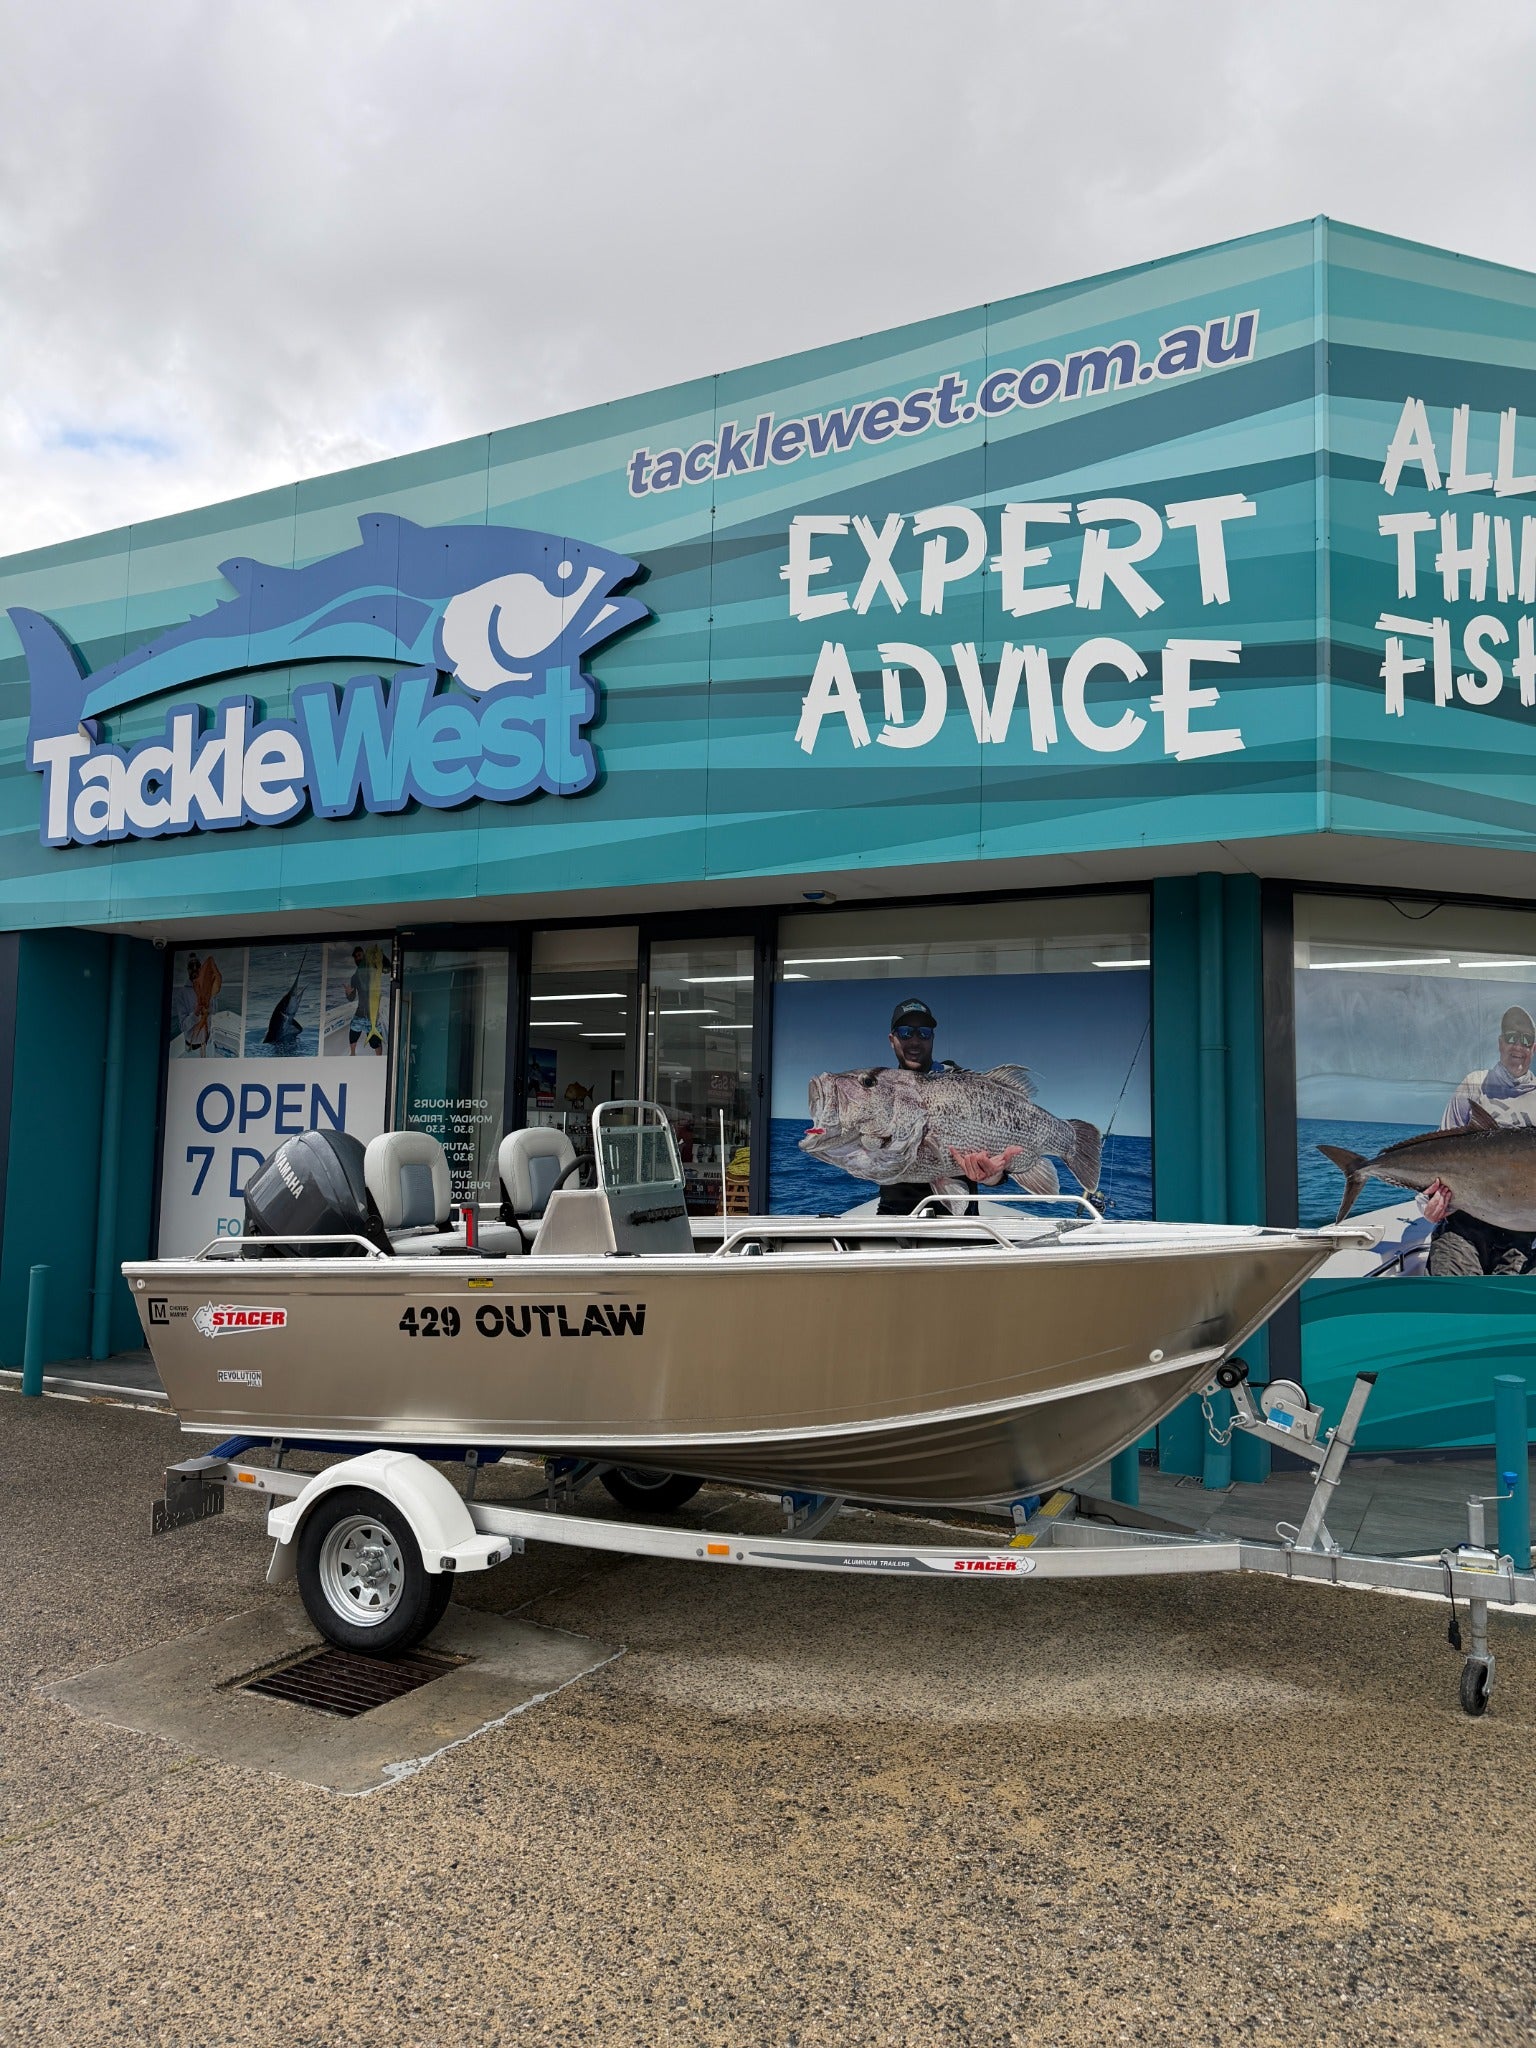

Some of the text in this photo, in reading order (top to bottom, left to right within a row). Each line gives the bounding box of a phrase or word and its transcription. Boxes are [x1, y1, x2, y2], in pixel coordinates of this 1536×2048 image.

[628, 309, 1259, 497] tacklewest.com.au
[1379, 396, 1536, 497] ALL
[780, 493, 1256, 622] EXPERT
[795, 637, 1246, 761] ADVICE
[196, 1082, 347, 1135] OPEN
[186, 1146, 215, 1195] 7
[275, 1150, 304, 1199] YAMAHA
[213, 1311, 285, 1326] STACER
[399, 1304, 646, 1337] 429 OUTLAW
[218, 1371, 261, 1381] REVOLUTION
[843, 1558, 878, 1566] ALUMINIUM
[954, 1560, 1017, 1571] STACER
